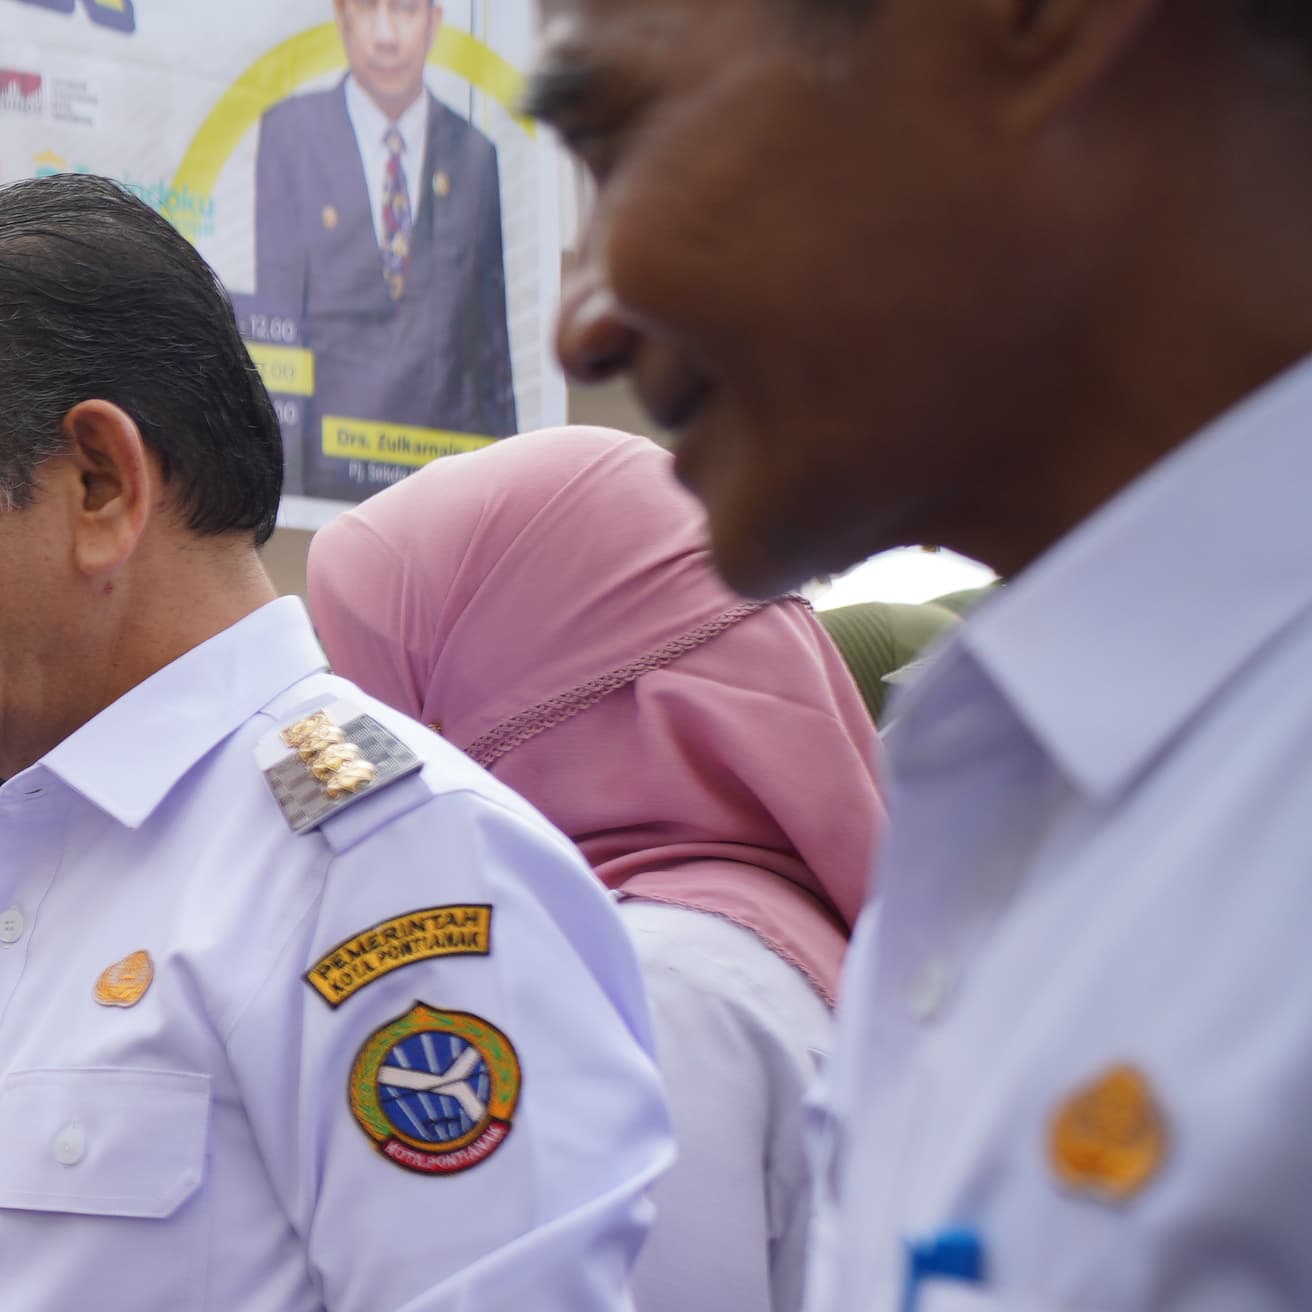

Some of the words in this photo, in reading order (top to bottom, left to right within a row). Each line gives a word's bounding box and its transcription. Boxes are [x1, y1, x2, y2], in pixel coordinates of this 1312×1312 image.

[319, 909, 479, 979] PEMERINTAH
[330, 956, 376, 993] KOTA
[378, 931, 480, 961] PONTIANAK
